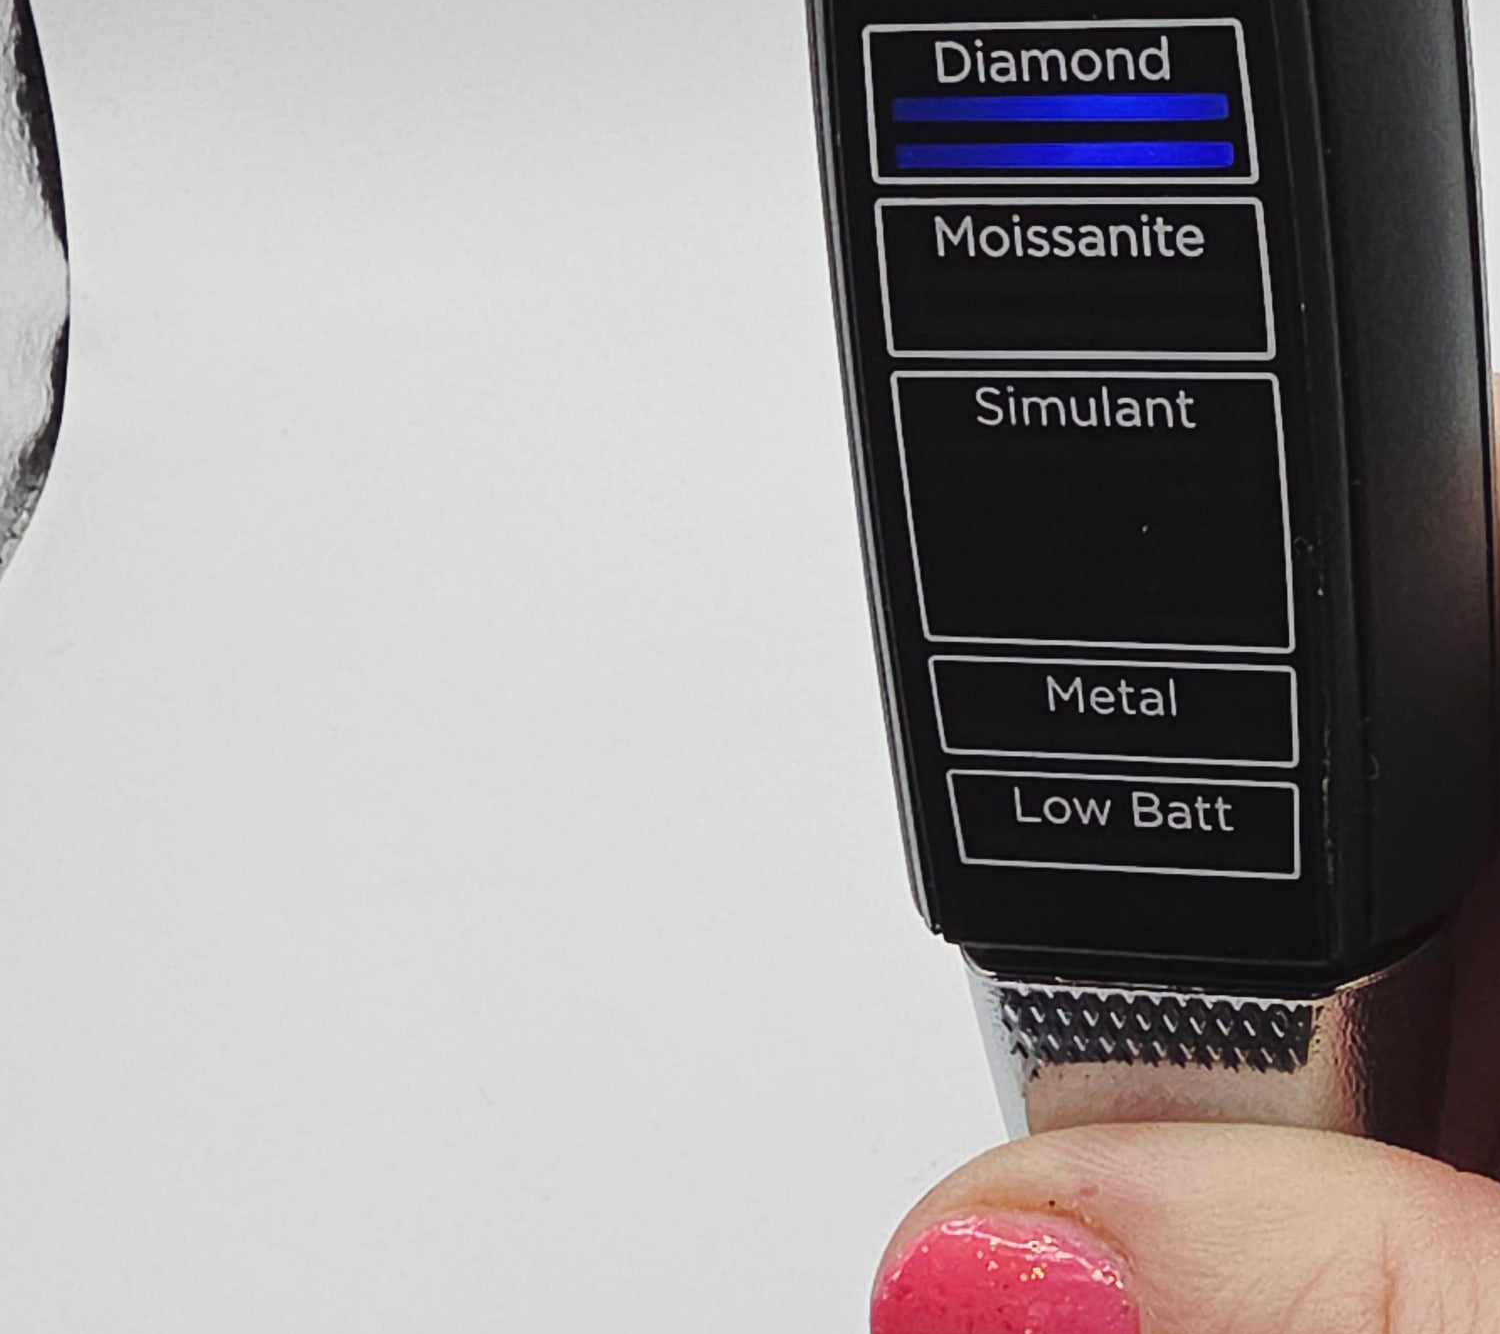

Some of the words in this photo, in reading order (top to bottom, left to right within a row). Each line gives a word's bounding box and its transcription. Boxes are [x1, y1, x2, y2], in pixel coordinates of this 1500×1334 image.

[935, 36, 1170, 83] Diamond
[935, 214, 1204, 257] Moissanite
[976, 386, 1196, 428] Simulant
[1047, 676, 1176, 716] Metal
[1014, 787, 1111, 825] Low
[1132, 792, 1233, 831] Batt
